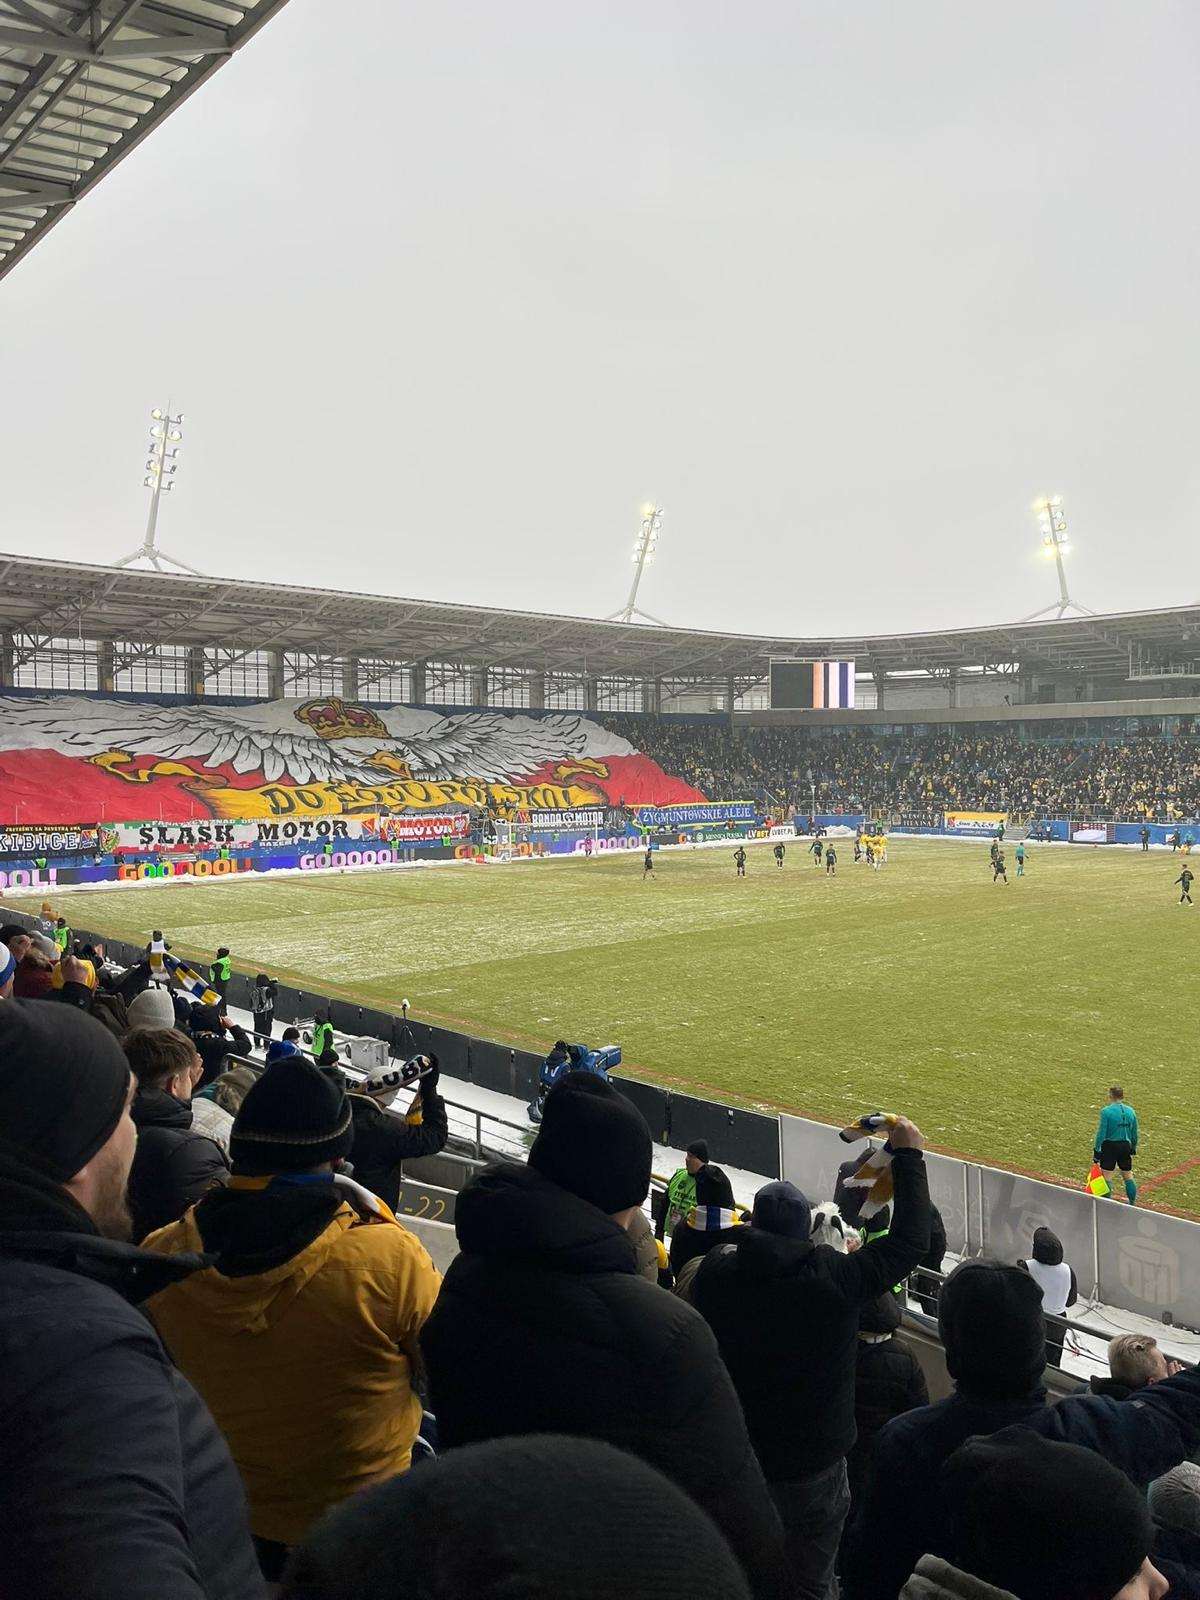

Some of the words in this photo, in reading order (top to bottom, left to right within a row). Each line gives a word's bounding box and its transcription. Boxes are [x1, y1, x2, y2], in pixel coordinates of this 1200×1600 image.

[260, 787, 323, 815] DO
[437, 784, 571, 808] POSKO!
[575, 811, 604, 826] MOTOR
[643, 808, 722, 825] ZYGMUNTOWSKIE
[724, 807, 751, 819] ALEJE
[257, 820, 348, 840] MOTOR
[399, 817, 452, 837] MOTOR
[748, 829, 769, 840] LVBET
[0, 831, 78, 852] KIBICE
